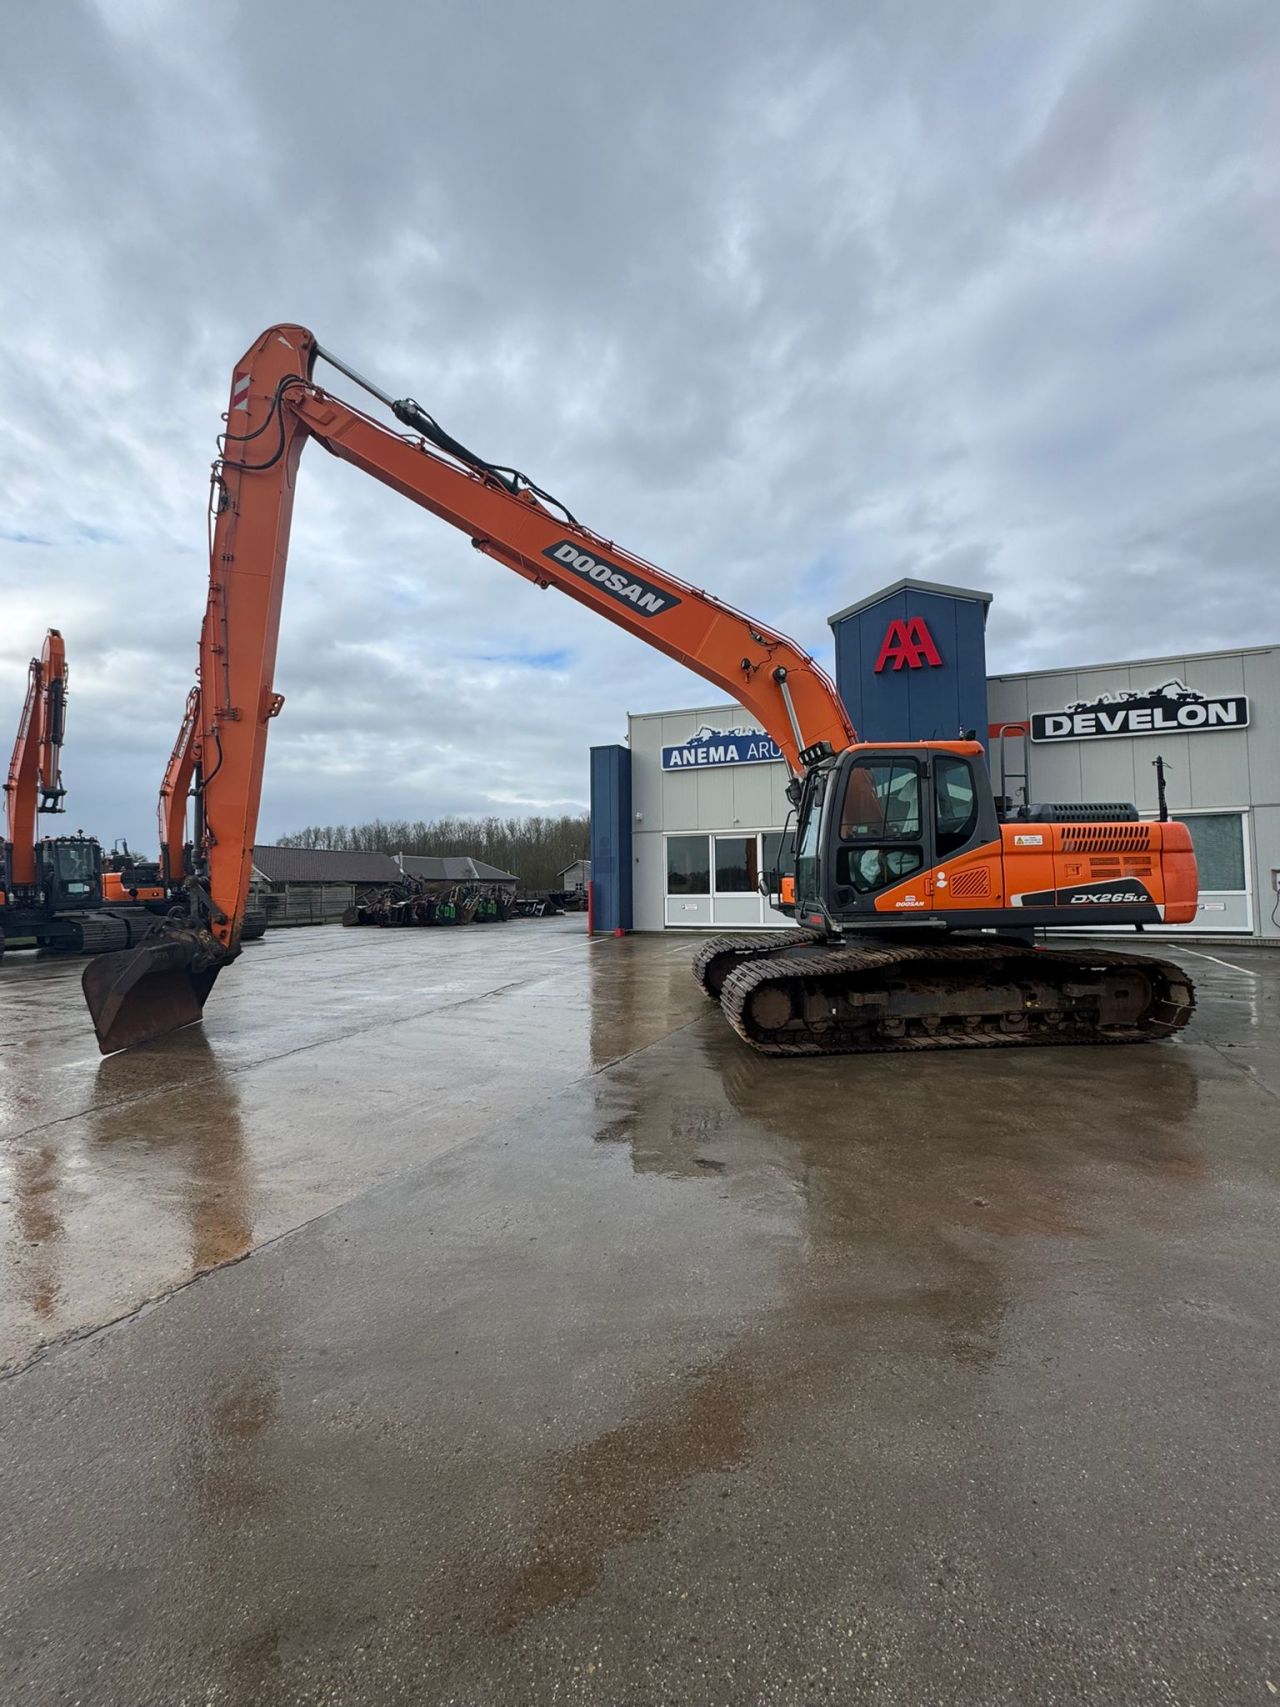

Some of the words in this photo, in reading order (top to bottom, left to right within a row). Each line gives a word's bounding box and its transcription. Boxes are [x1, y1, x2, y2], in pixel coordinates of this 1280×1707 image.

[553, 544, 665, 613] DOOSAN
[1044, 701, 1237, 737] DEVELON
[669, 744, 740, 766] ANEMA
[1070, 893, 1148, 904] DX265LC
